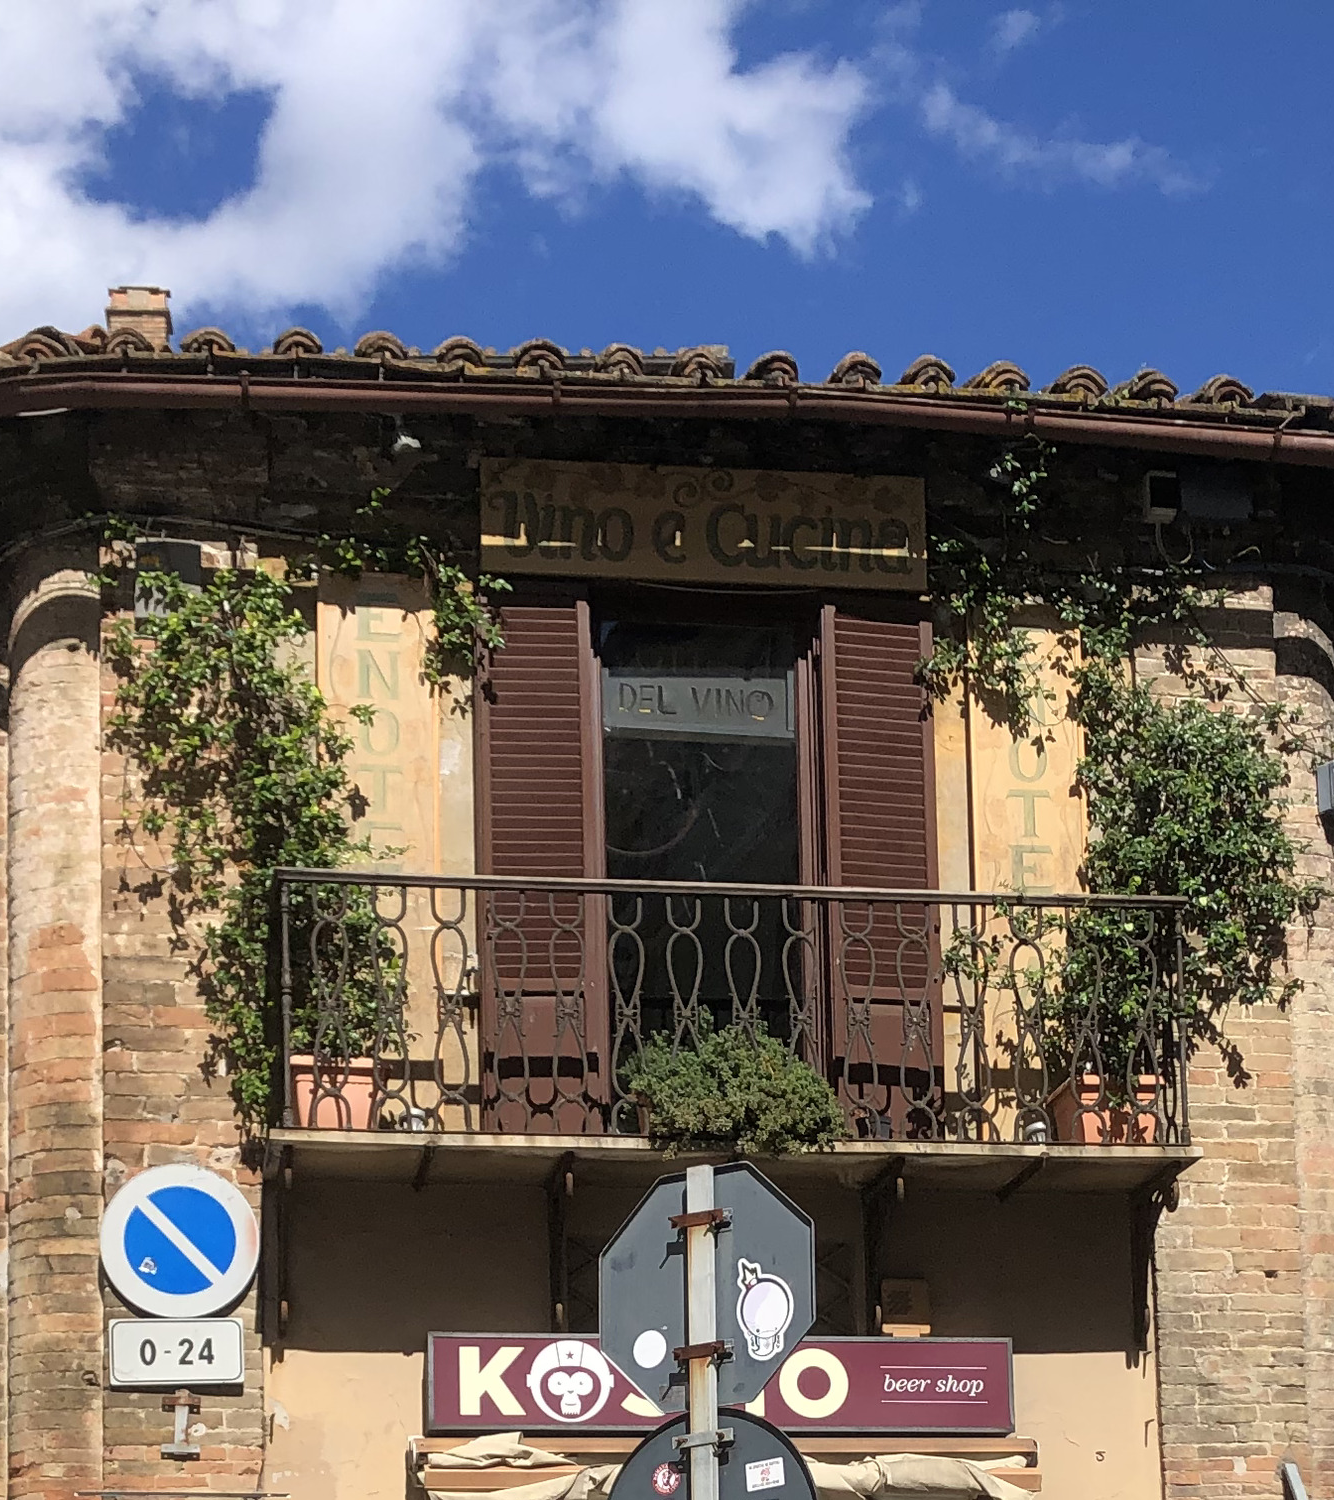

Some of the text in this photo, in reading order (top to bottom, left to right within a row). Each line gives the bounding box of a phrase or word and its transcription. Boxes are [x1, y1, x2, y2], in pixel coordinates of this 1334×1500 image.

[489, 489, 913, 575] Vino e Cucina
[619, 682, 774, 721] DEL VINO
[884, 1373, 931, 1393] beer
[935, 1374, 984, 1397] shop
